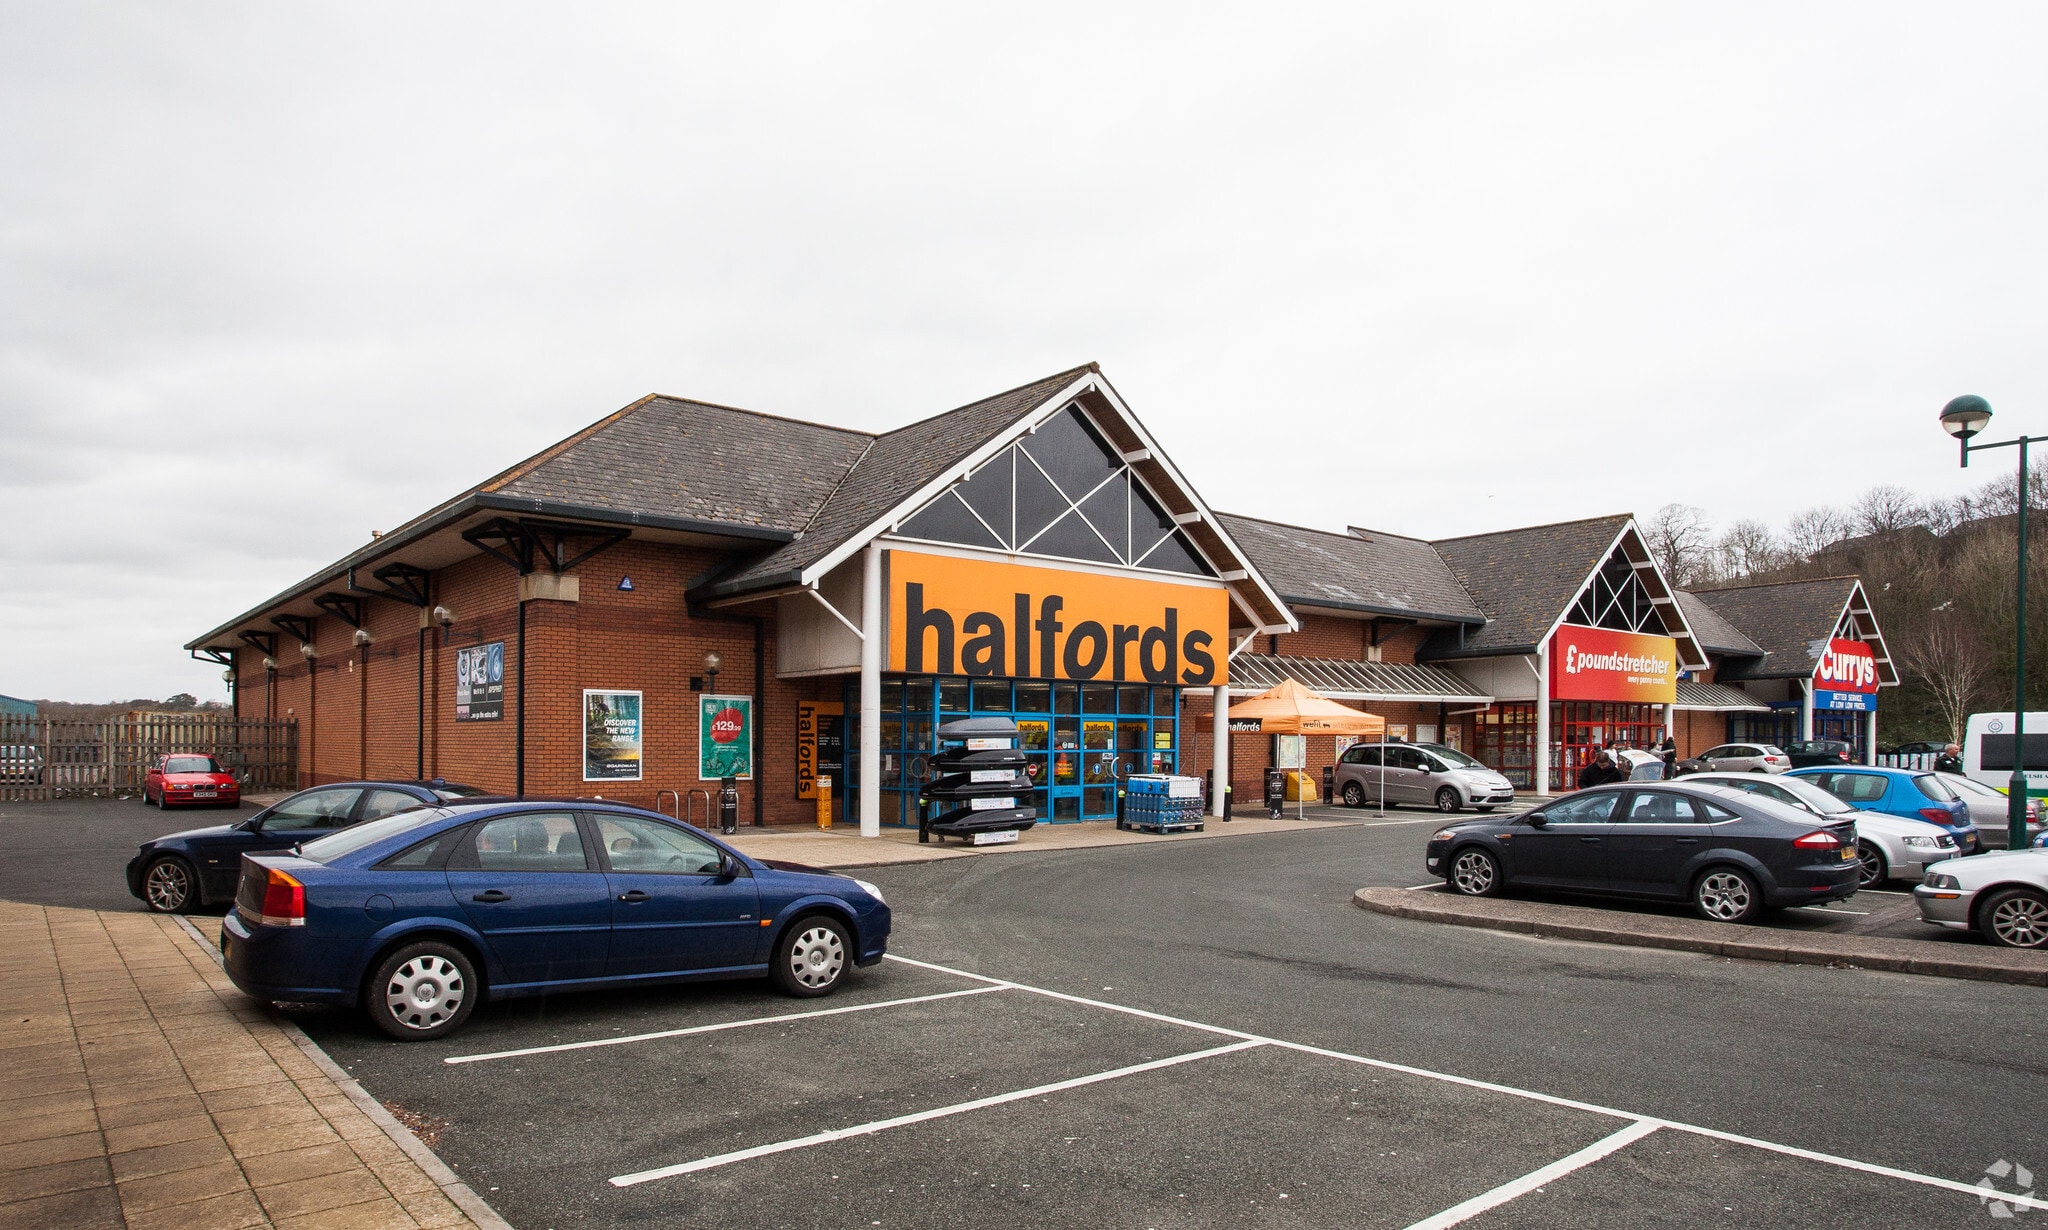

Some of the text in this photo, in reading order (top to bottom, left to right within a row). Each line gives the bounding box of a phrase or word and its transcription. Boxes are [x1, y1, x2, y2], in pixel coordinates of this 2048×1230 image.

[906, 582, 1215, 685] halfords
[1819, 644, 1874, 688] Currys
[604, 718, 637, 727] DISCOVER
[1019, 723, 1045, 731] halfords
[1086, 723, 1111, 731] halfords
[612, 735, 635, 743] RANGE
[799, 706, 815, 793] halfords
